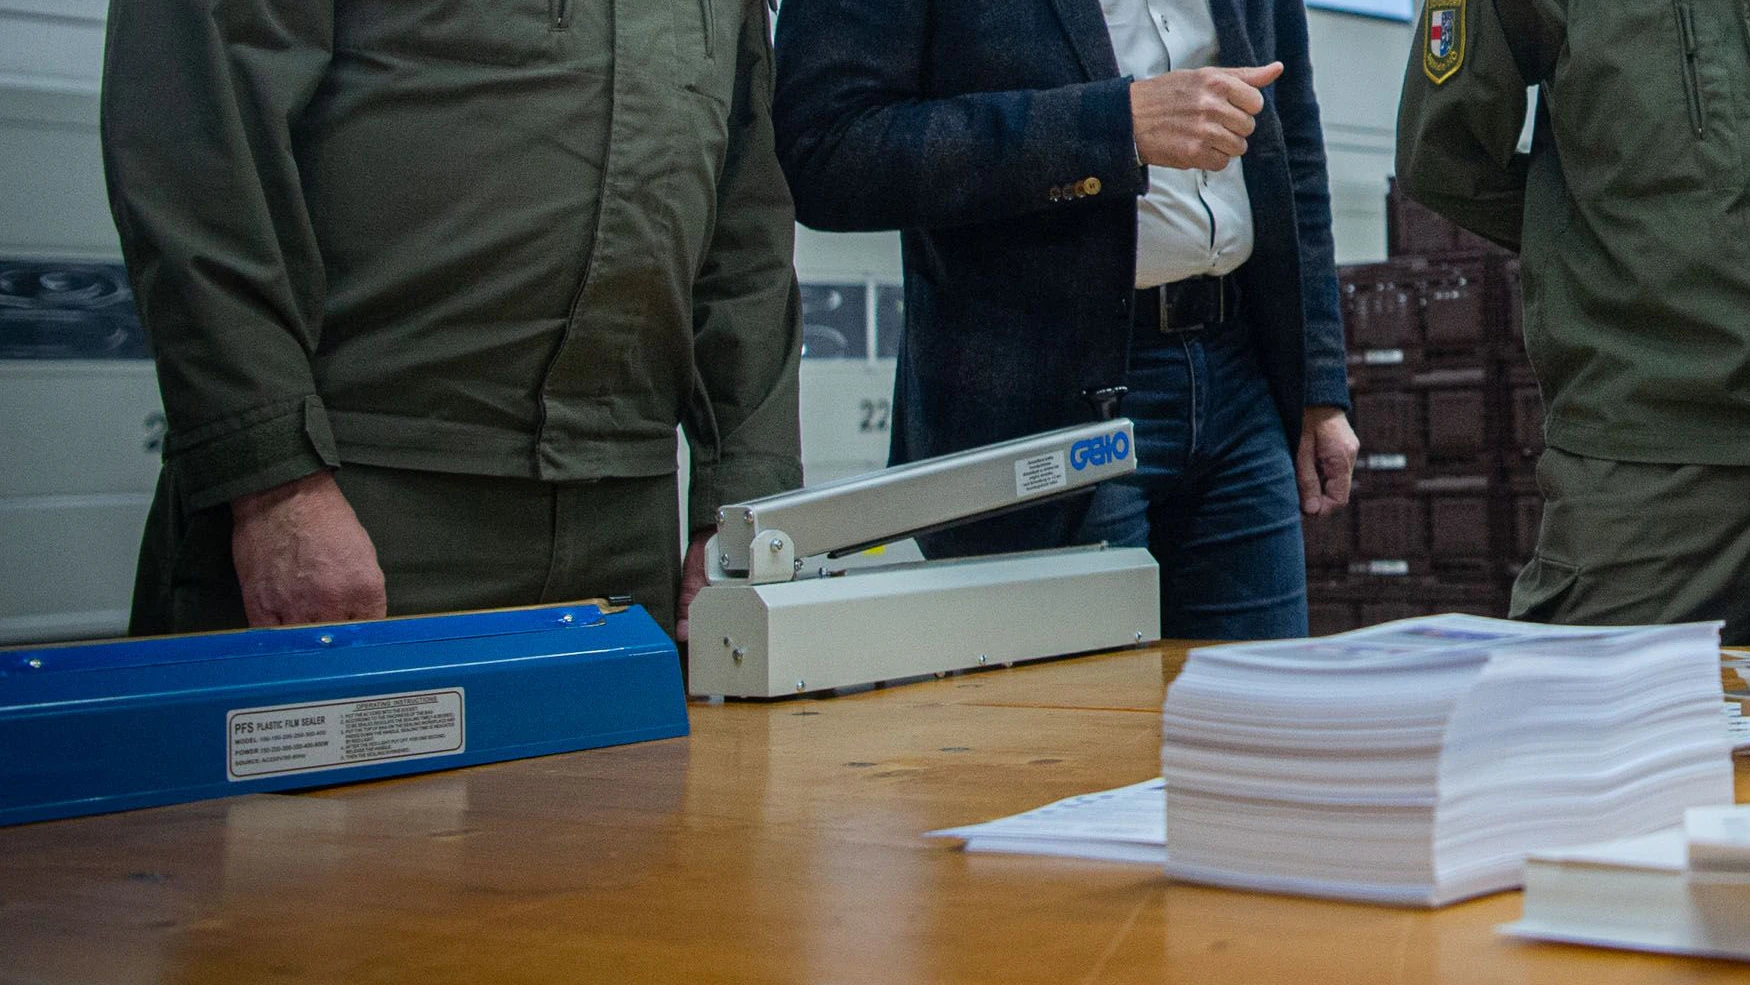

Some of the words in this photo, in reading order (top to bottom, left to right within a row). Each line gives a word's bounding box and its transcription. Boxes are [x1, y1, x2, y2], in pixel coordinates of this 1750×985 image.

[356, 700, 391, 710] OPERATING
[393, 696, 438, 706] INSTRUCTIONS
[235, 722, 254, 735] PFS
[256, 720, 283, 732] PLASTIC
[285, 719, 300, 728] FILM
[301, 716, 326, 726] SEALER
